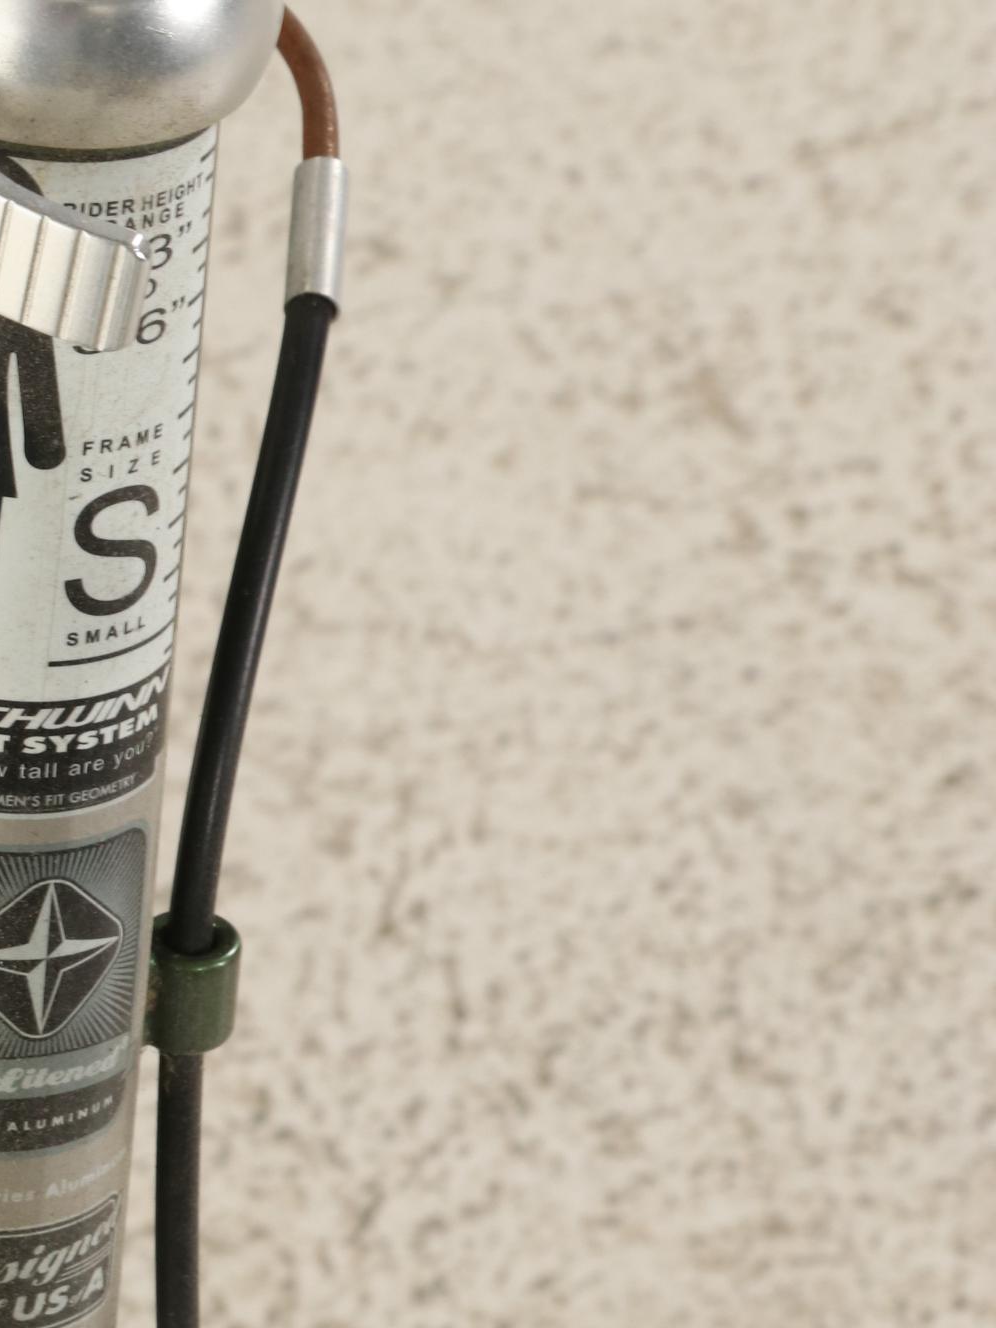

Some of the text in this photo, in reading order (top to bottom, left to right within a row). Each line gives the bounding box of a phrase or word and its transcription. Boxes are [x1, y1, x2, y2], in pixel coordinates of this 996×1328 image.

[141, 173, 204, 210] HEIGHT
[108, 203, 185, 230] ANGE
[82, 423, 163, 456] FRAME
[80, 450, 161, 482] SIZE
[64, 484, 160, 616] S
[66, 616, 146, 646] SMALL
[22, 704, 158, 754] SYSTEM
[19, 762, 57, 780] tall
[68, 757, 104, 776] are
[45, 793, 63, 806] FIT
[69, 771, 139, 804] GEOMETRY
[7, 1095, 113, 1132] ALUMINUM
